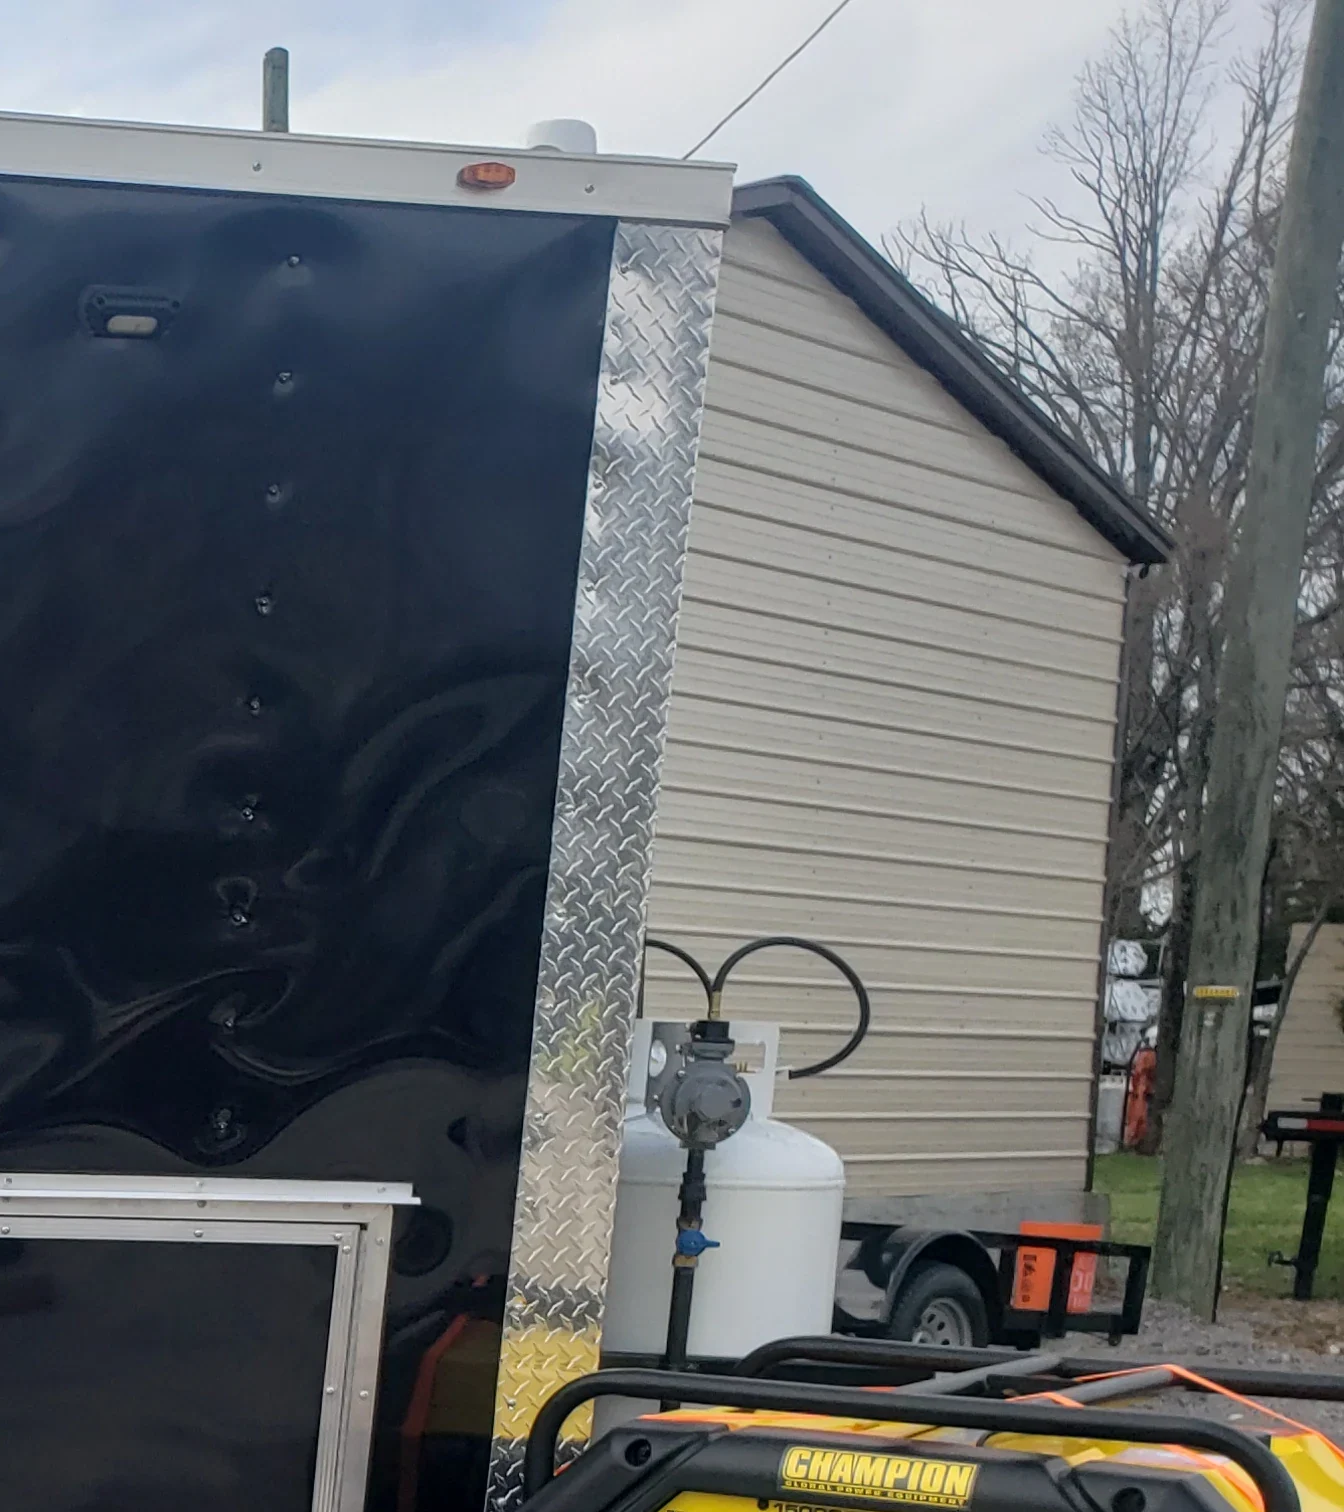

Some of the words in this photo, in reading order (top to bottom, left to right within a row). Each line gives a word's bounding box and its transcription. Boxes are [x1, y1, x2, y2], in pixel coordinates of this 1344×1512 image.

[786, 1450, 973, 1497] CHAMPION
[784, 1479, 832, 1492] GLOBAL
[837, 1485, 882, 1498] POWER
[887, 1490, 969, 1506] EQUIPMENT
